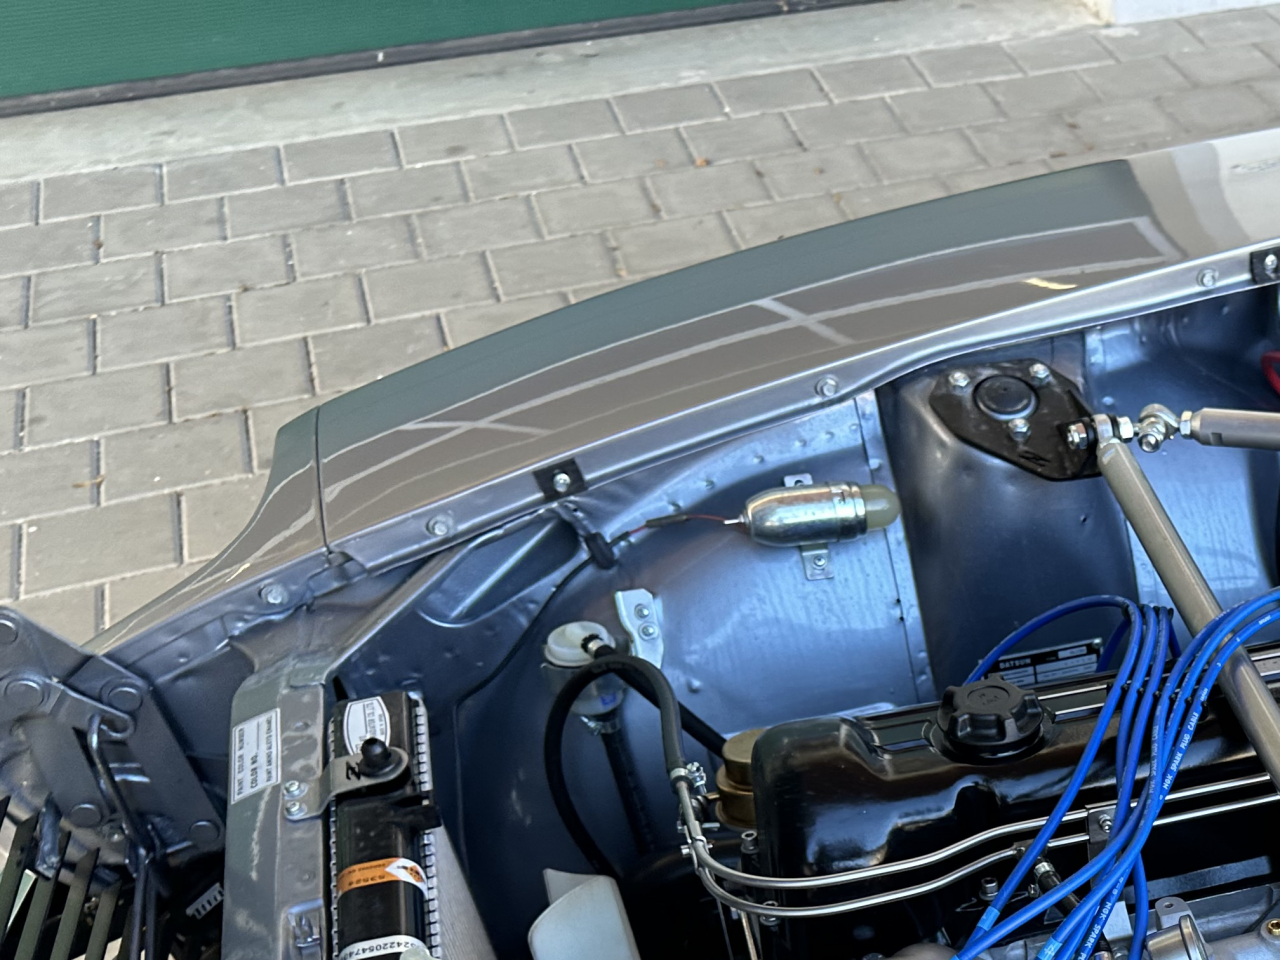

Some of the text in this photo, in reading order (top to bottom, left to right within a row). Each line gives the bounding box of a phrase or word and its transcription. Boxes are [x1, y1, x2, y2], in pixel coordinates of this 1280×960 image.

[1000, 659, 1030, 668] DATSUN
[1163, 774, 1173, 789] NGK
[1171, 752, 1182, 771] SPARK
[1180, 734, 1190, 749] PLUG
[1188, 712, 1198, 730] CABLE
[1100, 902, 1112, 920] NGK
[1085, 924, 1101, 948] SPARK
